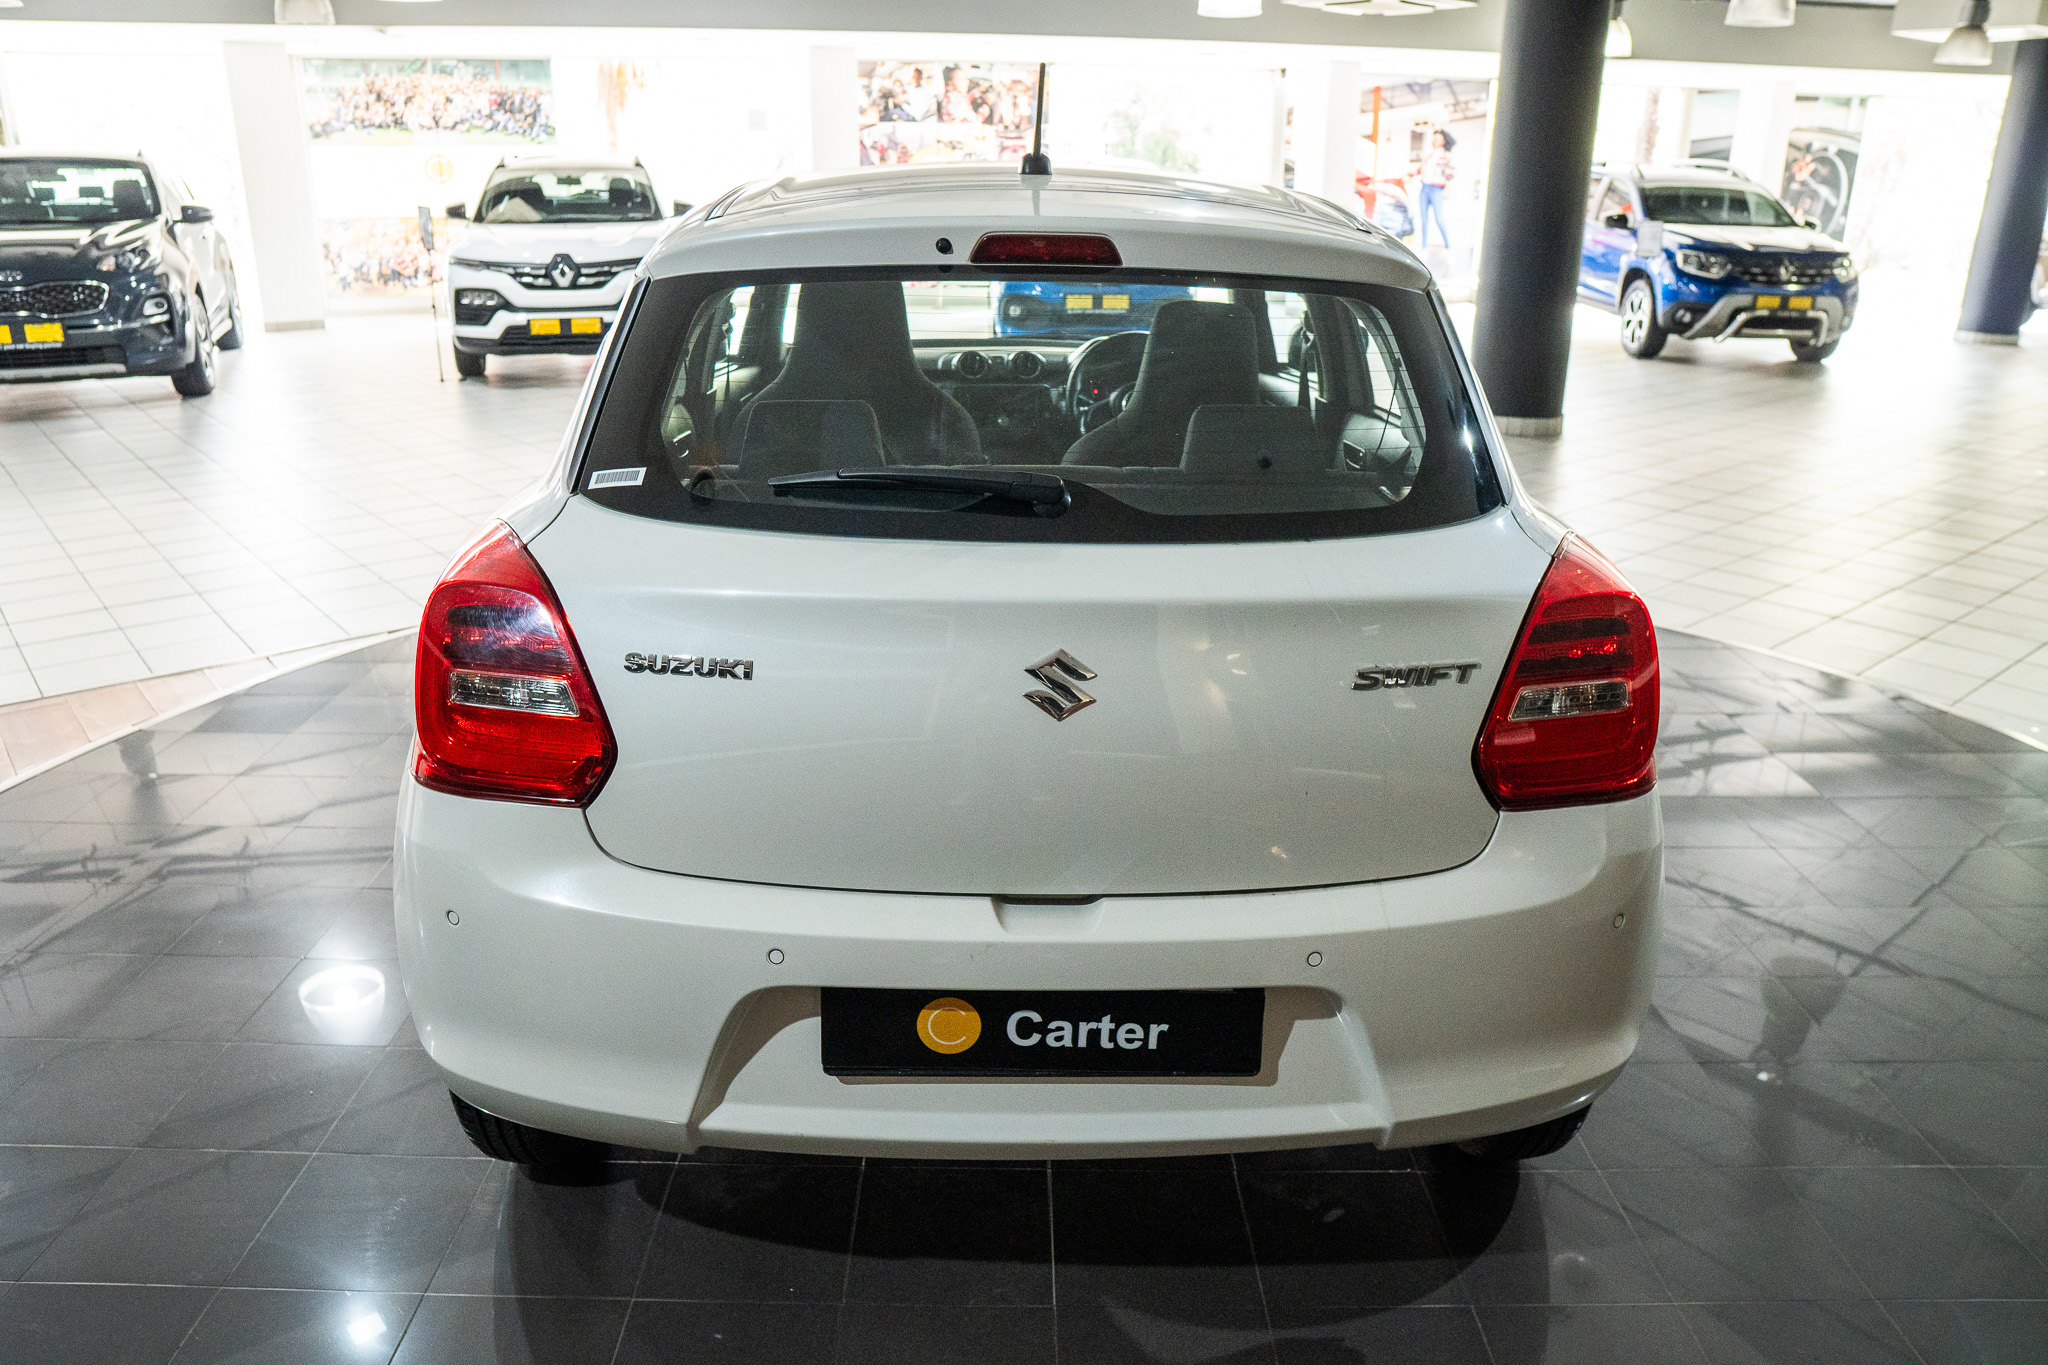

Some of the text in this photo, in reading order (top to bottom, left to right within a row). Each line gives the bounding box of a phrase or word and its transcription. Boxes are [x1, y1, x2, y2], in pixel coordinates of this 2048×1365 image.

[623, 652, 753, 680] SUZUKI
[1351, 662, 1481, 691] SWIFT
[1006, 1010, 1169, 1050] Carter
